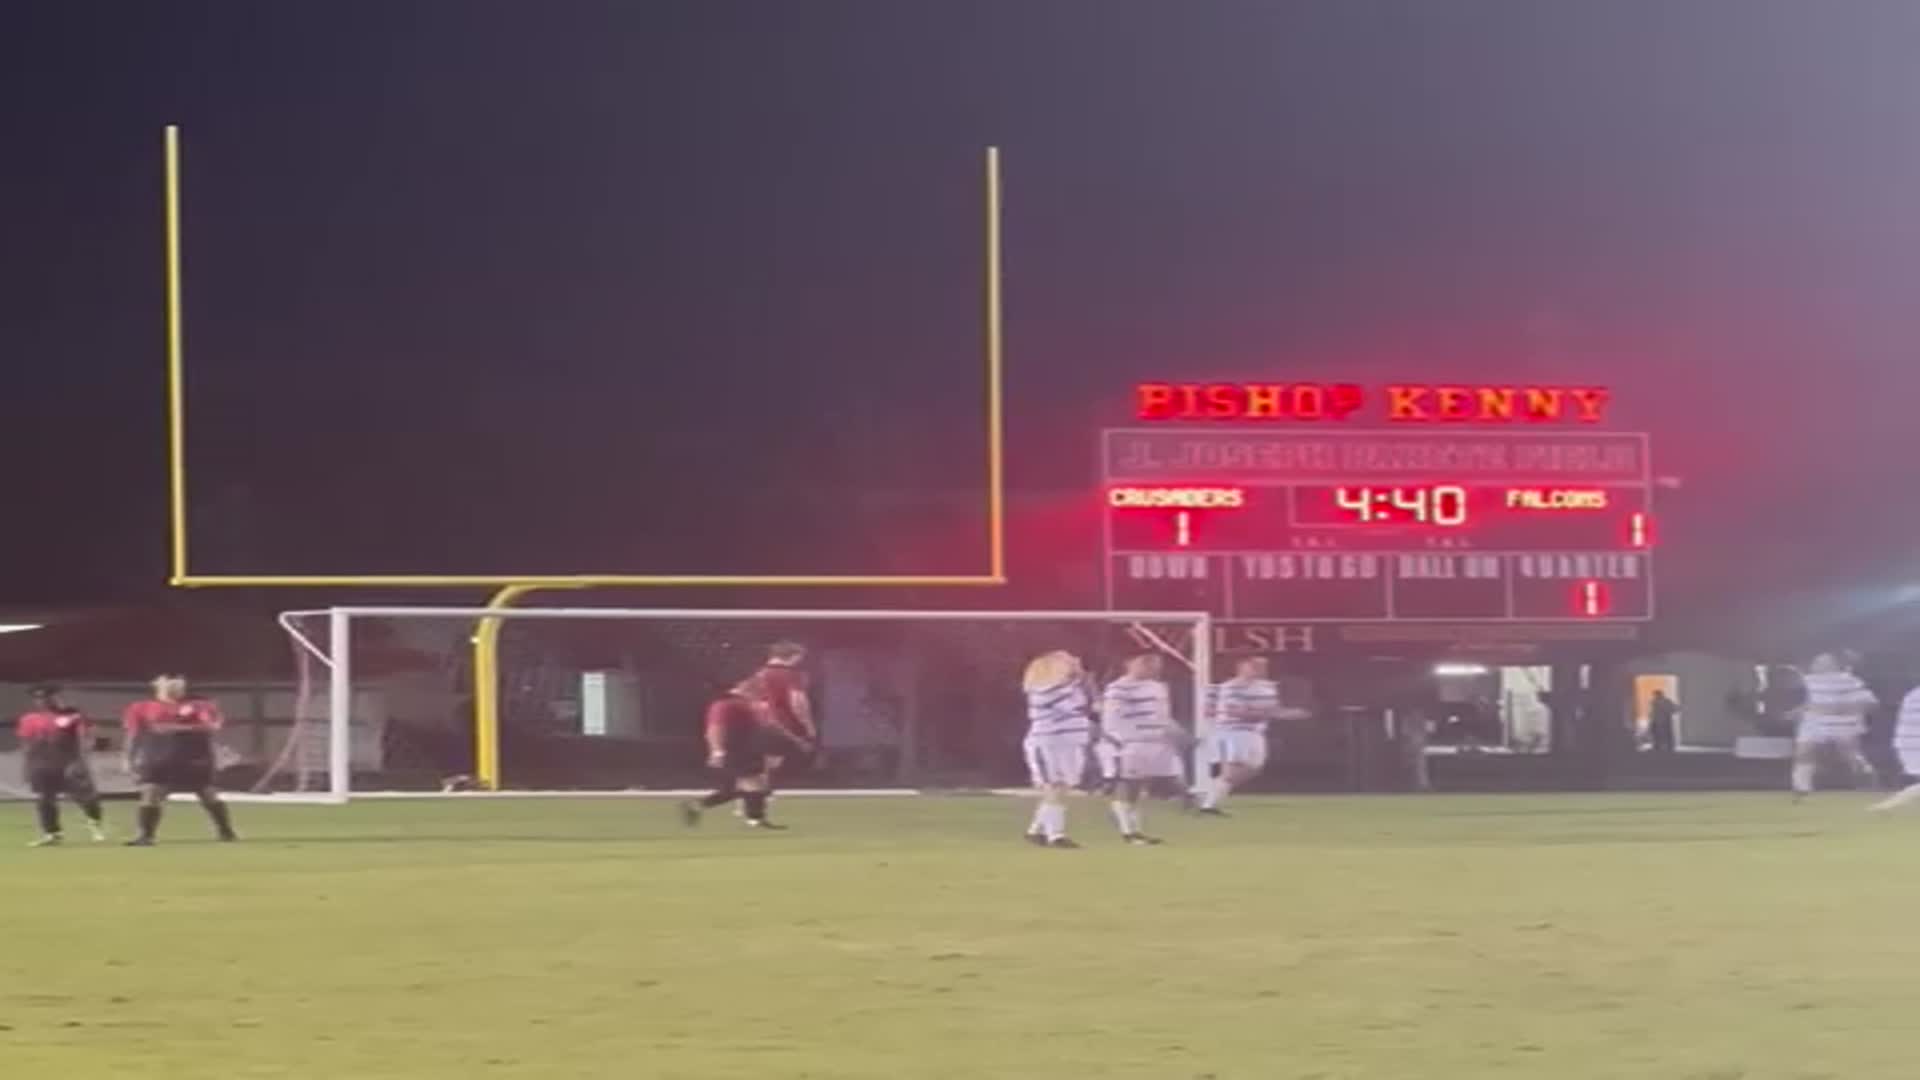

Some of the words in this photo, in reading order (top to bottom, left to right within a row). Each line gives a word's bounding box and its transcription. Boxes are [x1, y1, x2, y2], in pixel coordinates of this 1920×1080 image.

[1386, 385, 1609, 422] KENNY
[1109, 488, 1243, 507] CRUSADERS
[1336, 486, 1466, 526] 4:40
[1507, 490, 1607, 508] FALCONS
[1175, 511, 1190, 546] 1
[1630, 512, 1645, 547] 1
[1584, 581, 1599, 616] 1
[1125, 625, 1316, 653] WLSH
